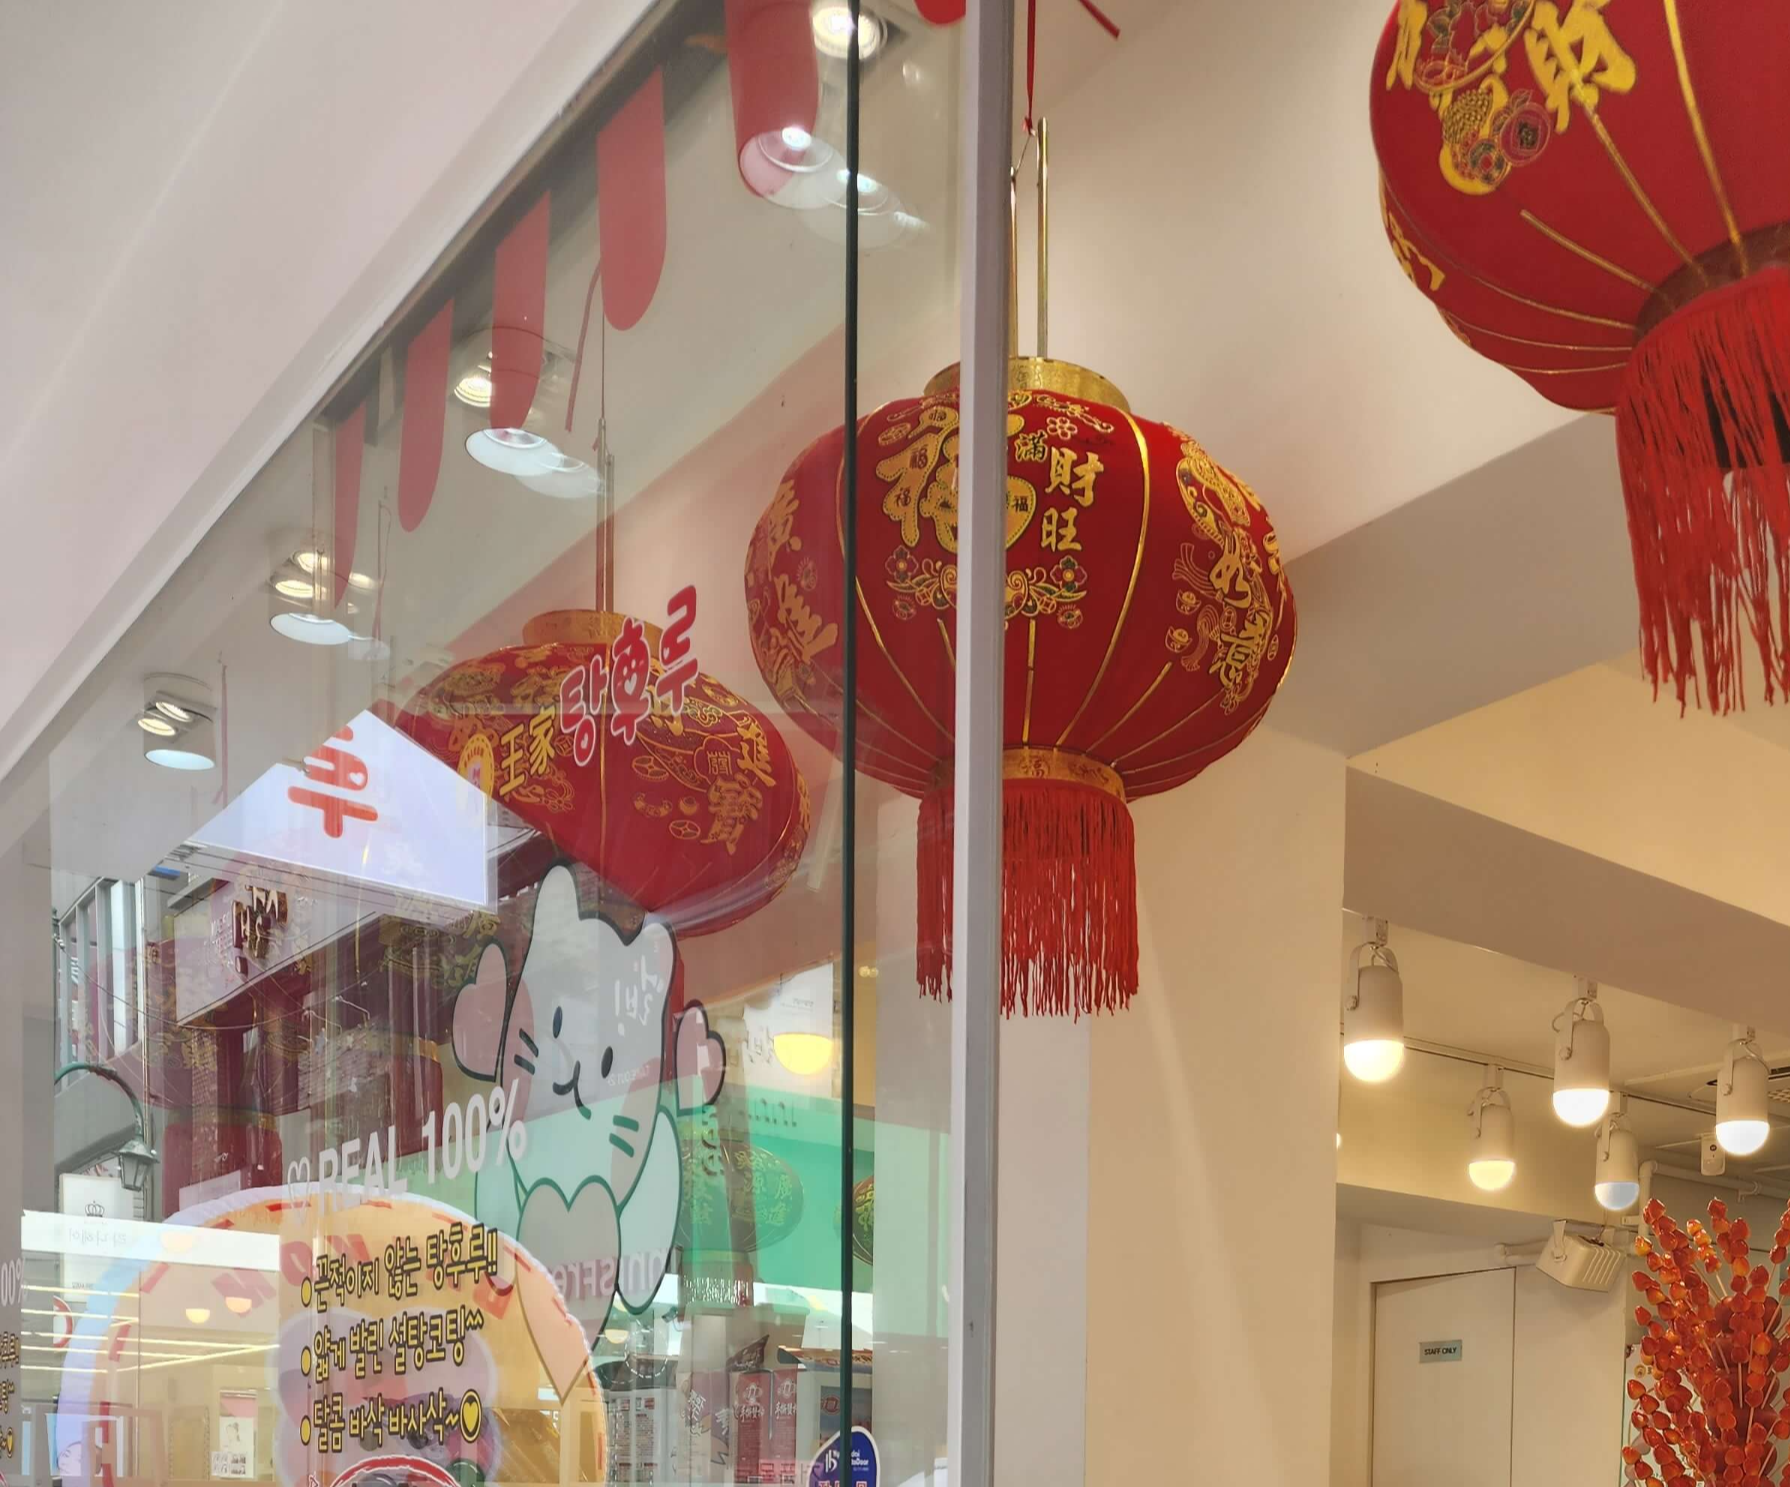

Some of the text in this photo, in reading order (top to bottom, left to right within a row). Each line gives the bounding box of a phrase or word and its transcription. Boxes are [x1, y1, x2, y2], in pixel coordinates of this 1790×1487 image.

[498, 584, 699, 796] 王家 탕후루
[318, 1078, 528, 1217] REAL 100%
[314, 1221, 498, 1313] 끈적이지 않는 탕후루!!
[314, 1325, 347, 1383] 얇게
[350, 1318, 384, 1379] 발린
[313, 1392, 345, 1453] 달콤
[349, 1393, 384, 1447] 바삭
